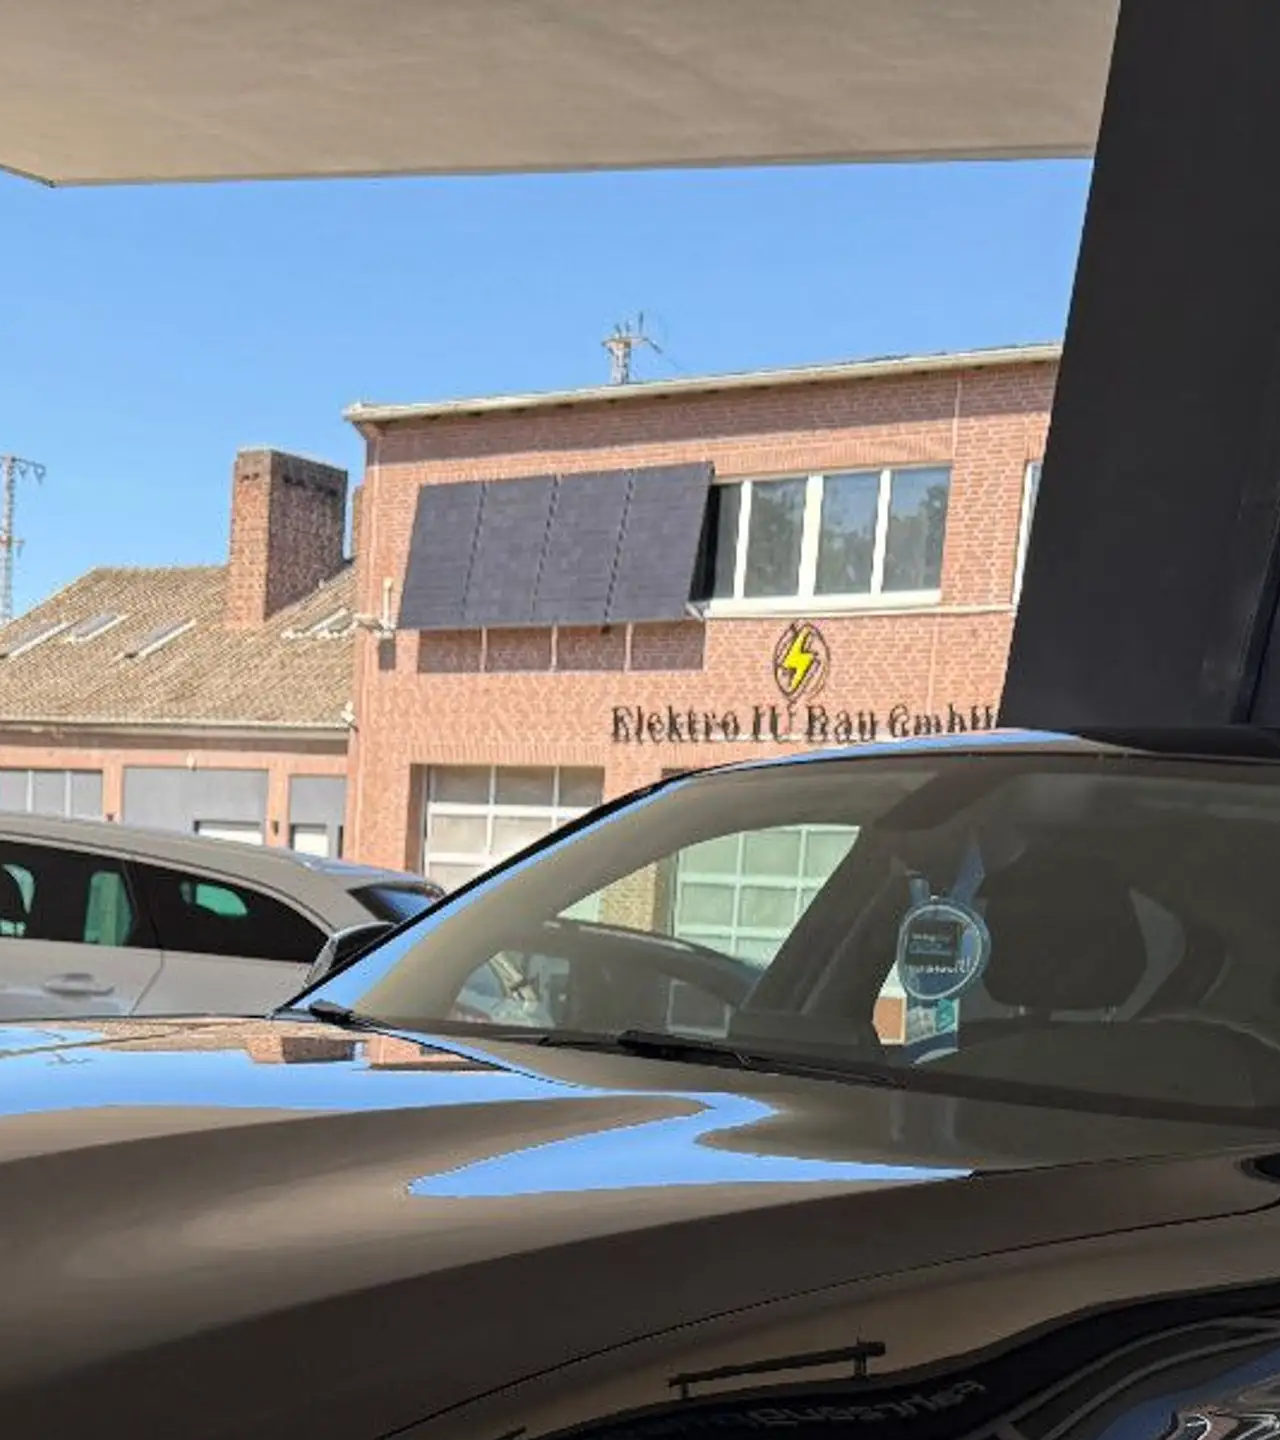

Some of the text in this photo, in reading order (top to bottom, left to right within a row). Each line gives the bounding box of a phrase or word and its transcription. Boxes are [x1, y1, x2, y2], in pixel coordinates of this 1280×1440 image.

[611, 704, 741, 744] Elektro
[806, 703, 878, 744] Bau
[888, 702, 994, 738] GmbH
